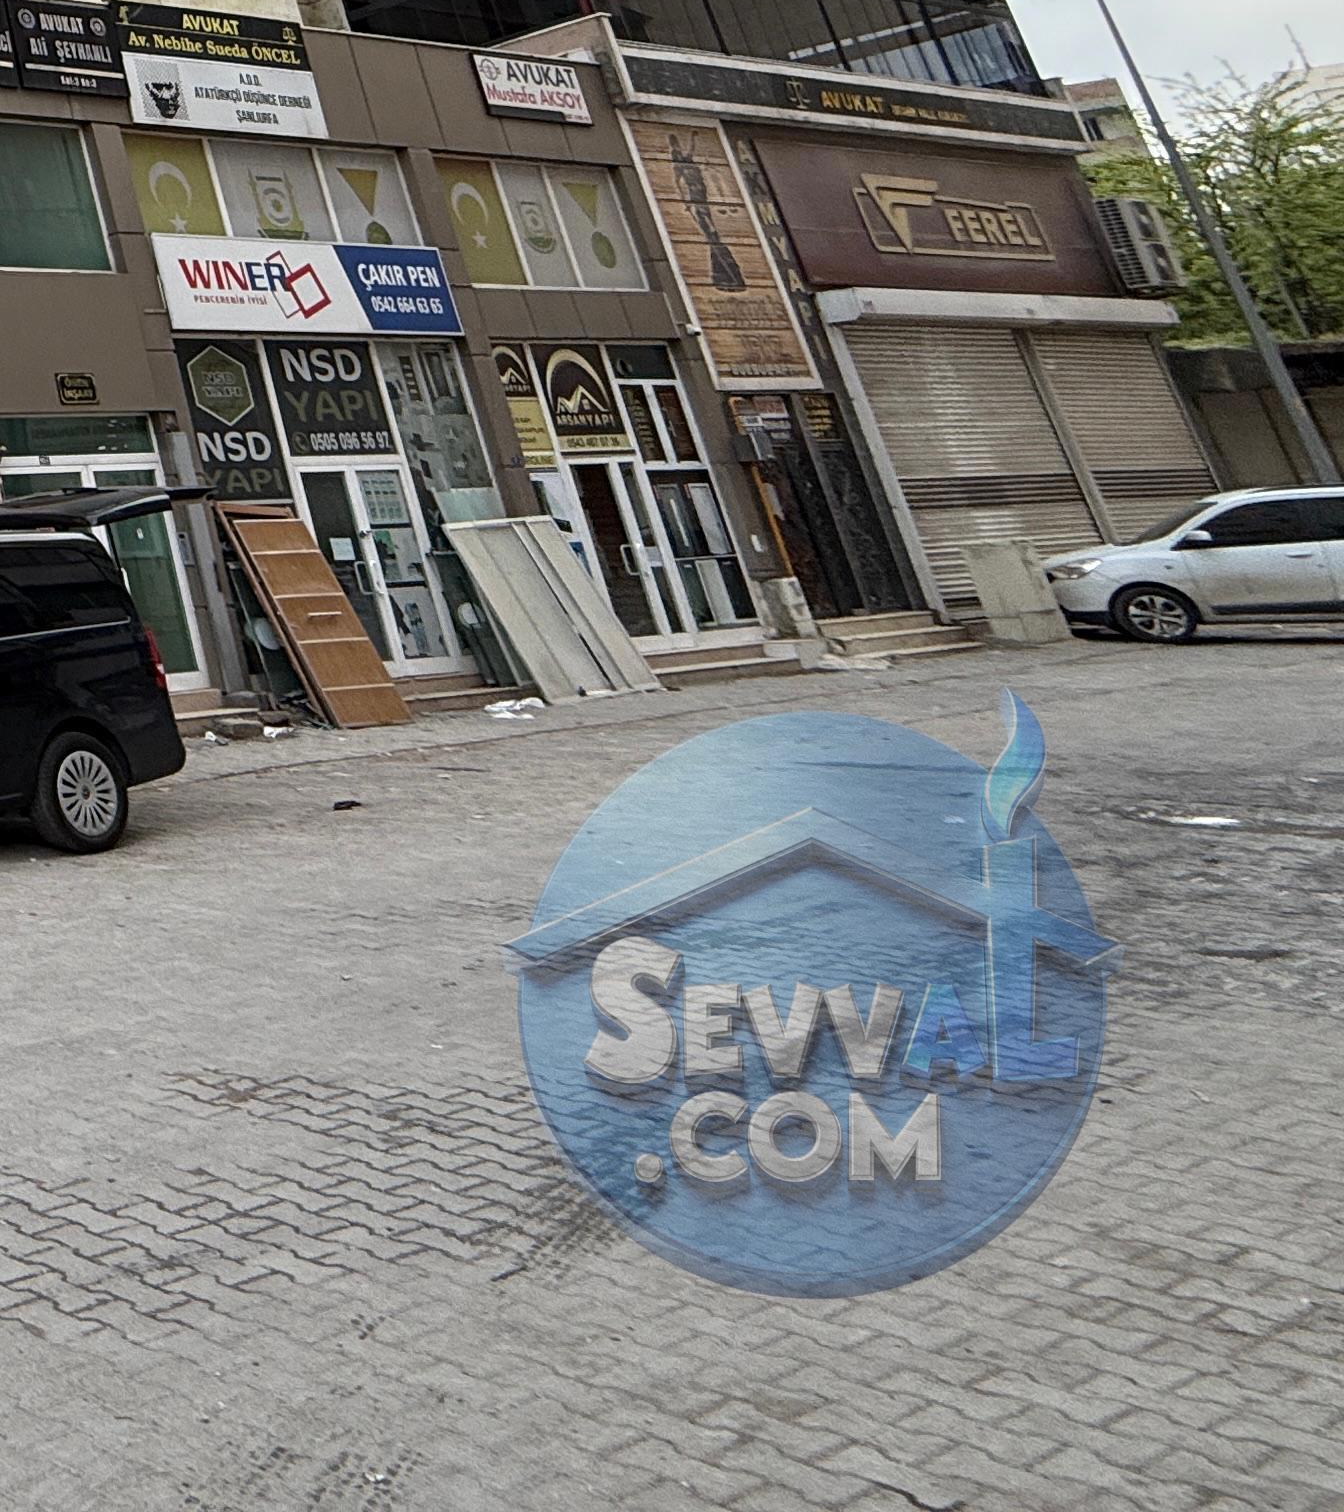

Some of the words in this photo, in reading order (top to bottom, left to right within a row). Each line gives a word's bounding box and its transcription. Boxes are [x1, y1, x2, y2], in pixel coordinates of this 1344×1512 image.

[39, 13, 85, 35] AVUKAT
[182, 14, 240, 36] AVUKAT
[128, 31, 150, 48] Av.
[154, 34, 204, 53] Nebihe
[206, 42, 250, 59] Sueda
[252, 43, 301, 65] ÖNCEL
[506, 61, 575, 89] AVUKAT
[485, 83, 538, 104] Mustafa
[540, 89, 583, 109] AKSOY
[820, 91, 884, 114] AVUKAT
[944, 208, 1043, 246] FEREL
[178, 258, 292, 293] WINER
[357, 263, 406, 291] ÇAKIR
[410, 265, 441, 288] PEN
[370, 296, 397, 313] 0542
[398, 296, 416, 313] 664
[416, 297, 429, 314] 63
[429, 298, 444, 315] 65
[280, 347, 362, 383] NSD
[283, 390, 379, 423] YAPI
[196, 431, 272, 462] NSD
[310, 432, 339, 452] 0505
[339, 432, 360, 450] 096
[361, 431, 376, 449] 56
